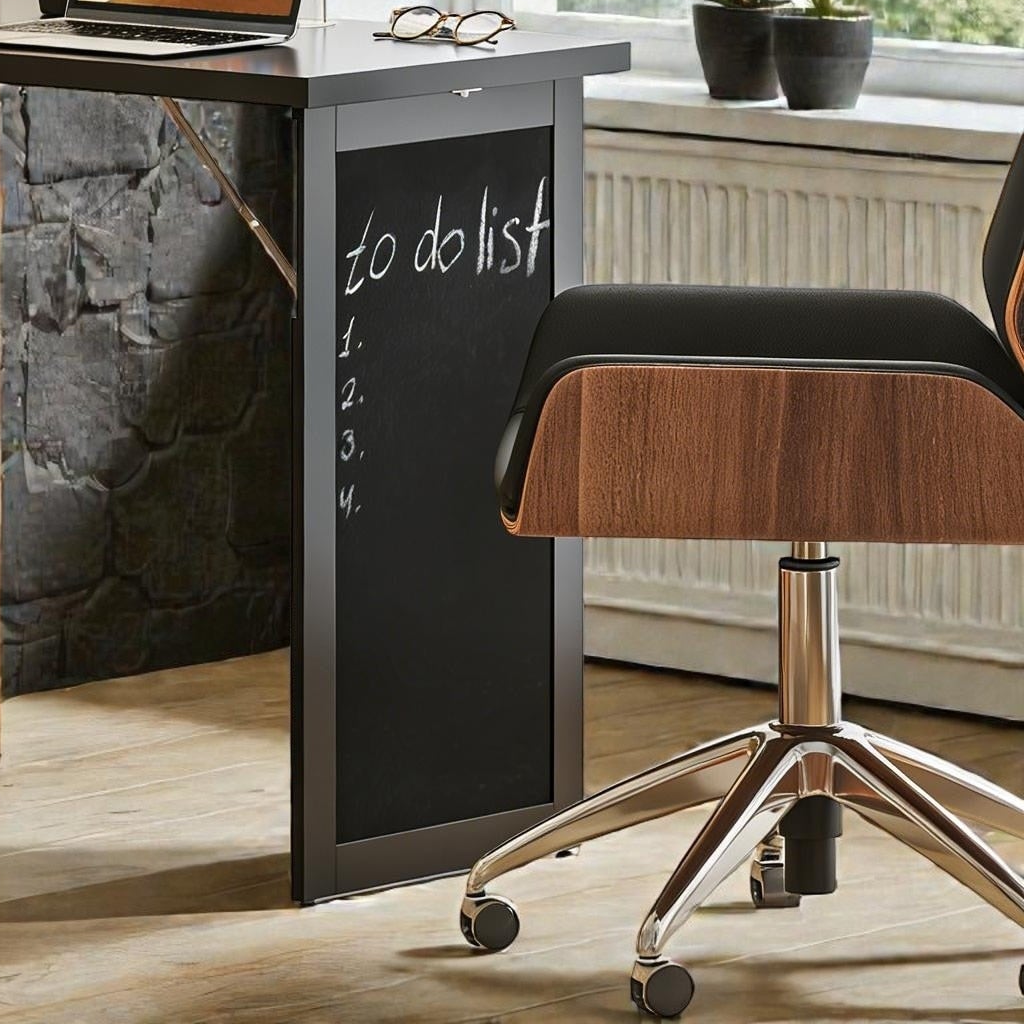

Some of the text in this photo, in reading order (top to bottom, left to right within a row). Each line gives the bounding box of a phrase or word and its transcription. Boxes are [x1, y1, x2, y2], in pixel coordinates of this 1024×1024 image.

[345, 176, 550, 295] to do list
